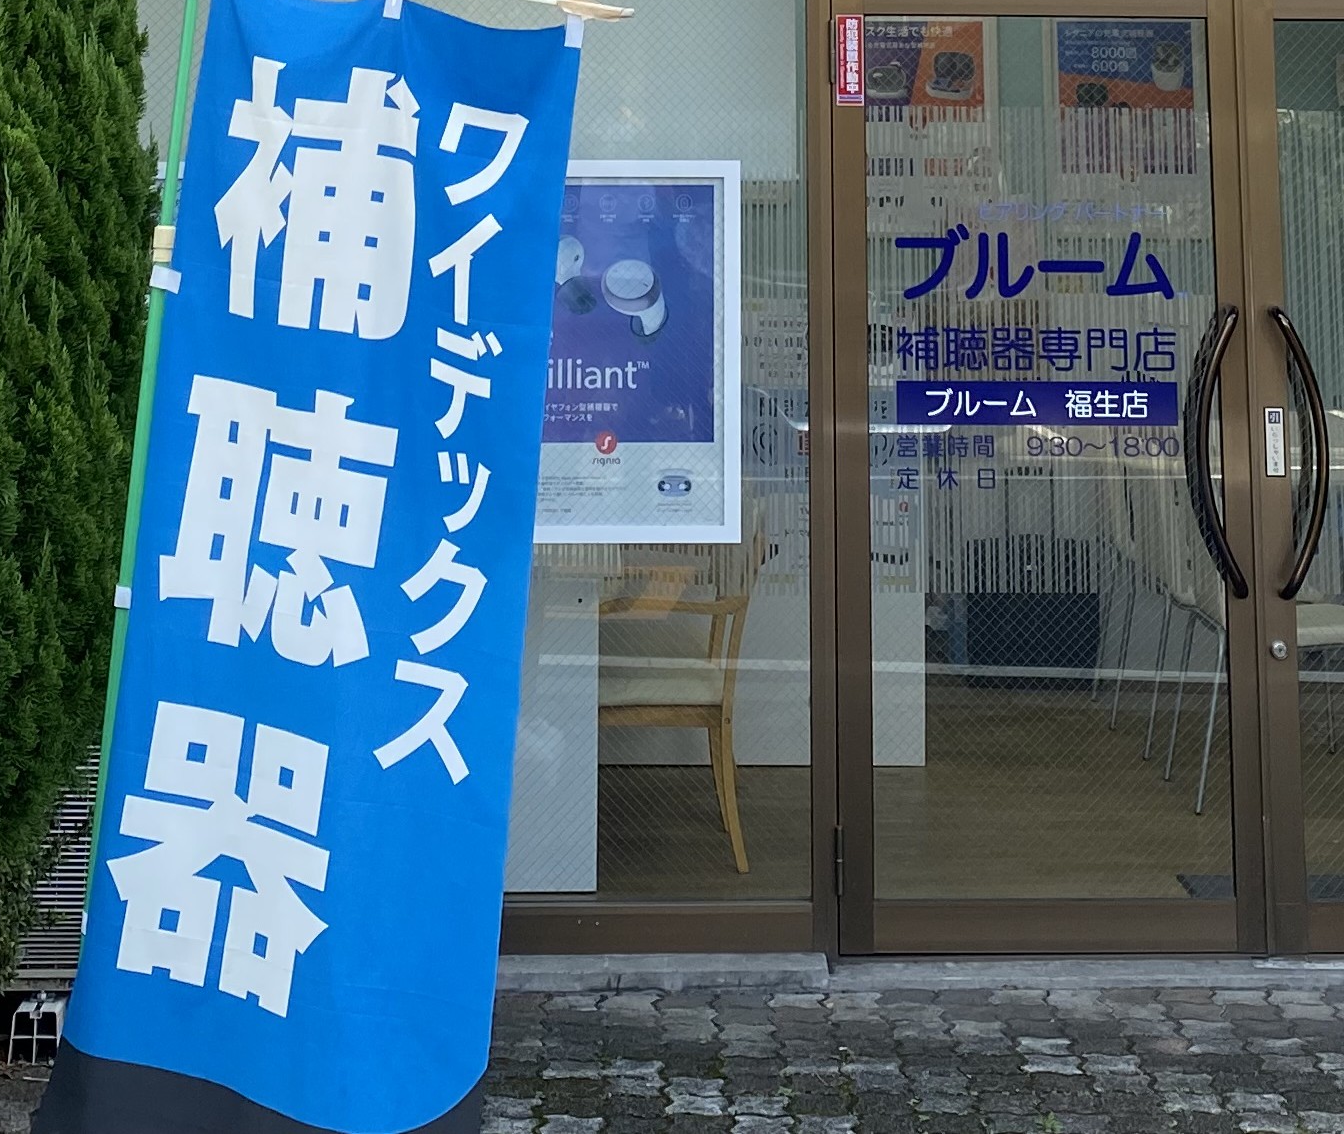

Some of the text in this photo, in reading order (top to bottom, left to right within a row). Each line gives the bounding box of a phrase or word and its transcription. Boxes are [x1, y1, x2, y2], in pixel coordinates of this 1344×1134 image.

[979, 202, 1066, 220] ヒアリング
[895, 223, 1175, 300] ブルーム
[897, 326, 1176, 372] 補聴器専門店
[925, 388, 1149, 418] ブルーム 福生店
[373, 102, 530, 786] ワイデックス
[592, 457, 621, 466] signia
[897, 435, 995, 458] 営業時間
[106, 57, 422, 1020] 補聴器
